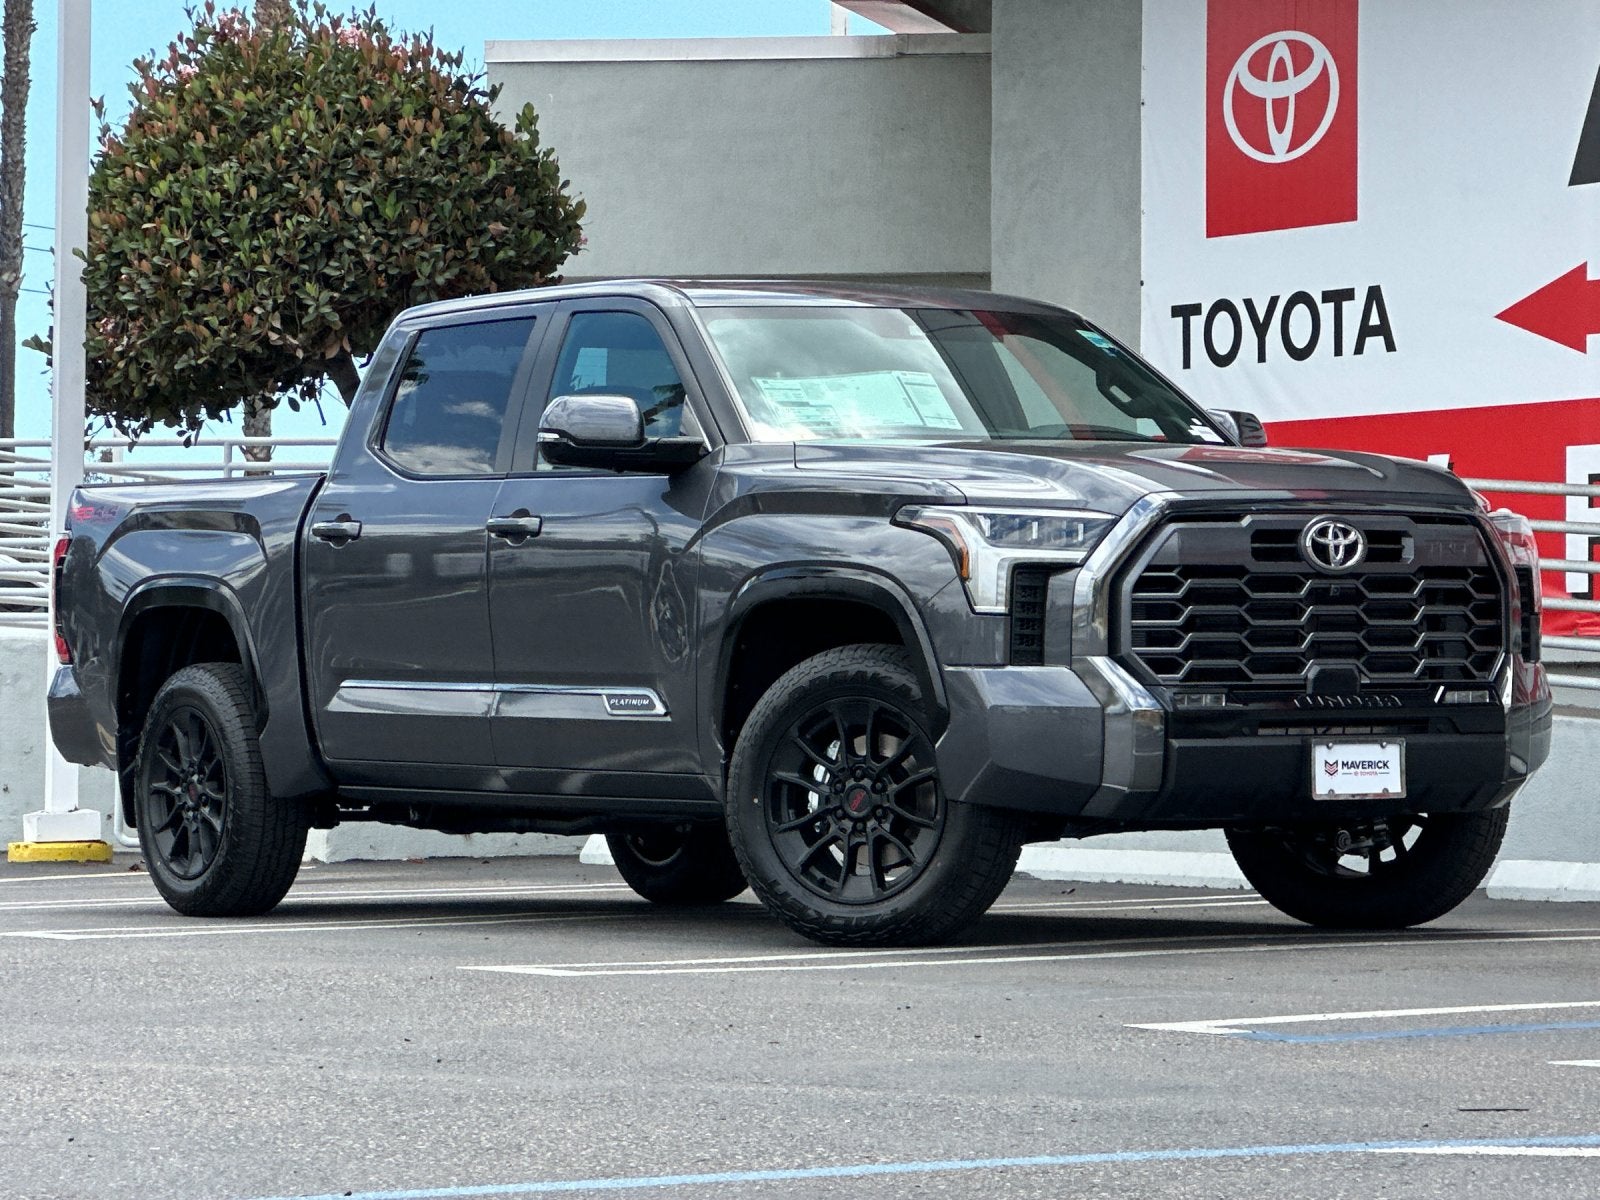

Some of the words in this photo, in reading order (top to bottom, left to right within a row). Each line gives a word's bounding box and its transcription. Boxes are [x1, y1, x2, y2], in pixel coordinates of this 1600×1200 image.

[1171, 284, 1397, 370] TOYOTA
[609, 698, 650, 706] PLATINUM
[1341, 760, 1390, 770] MAVERICK
